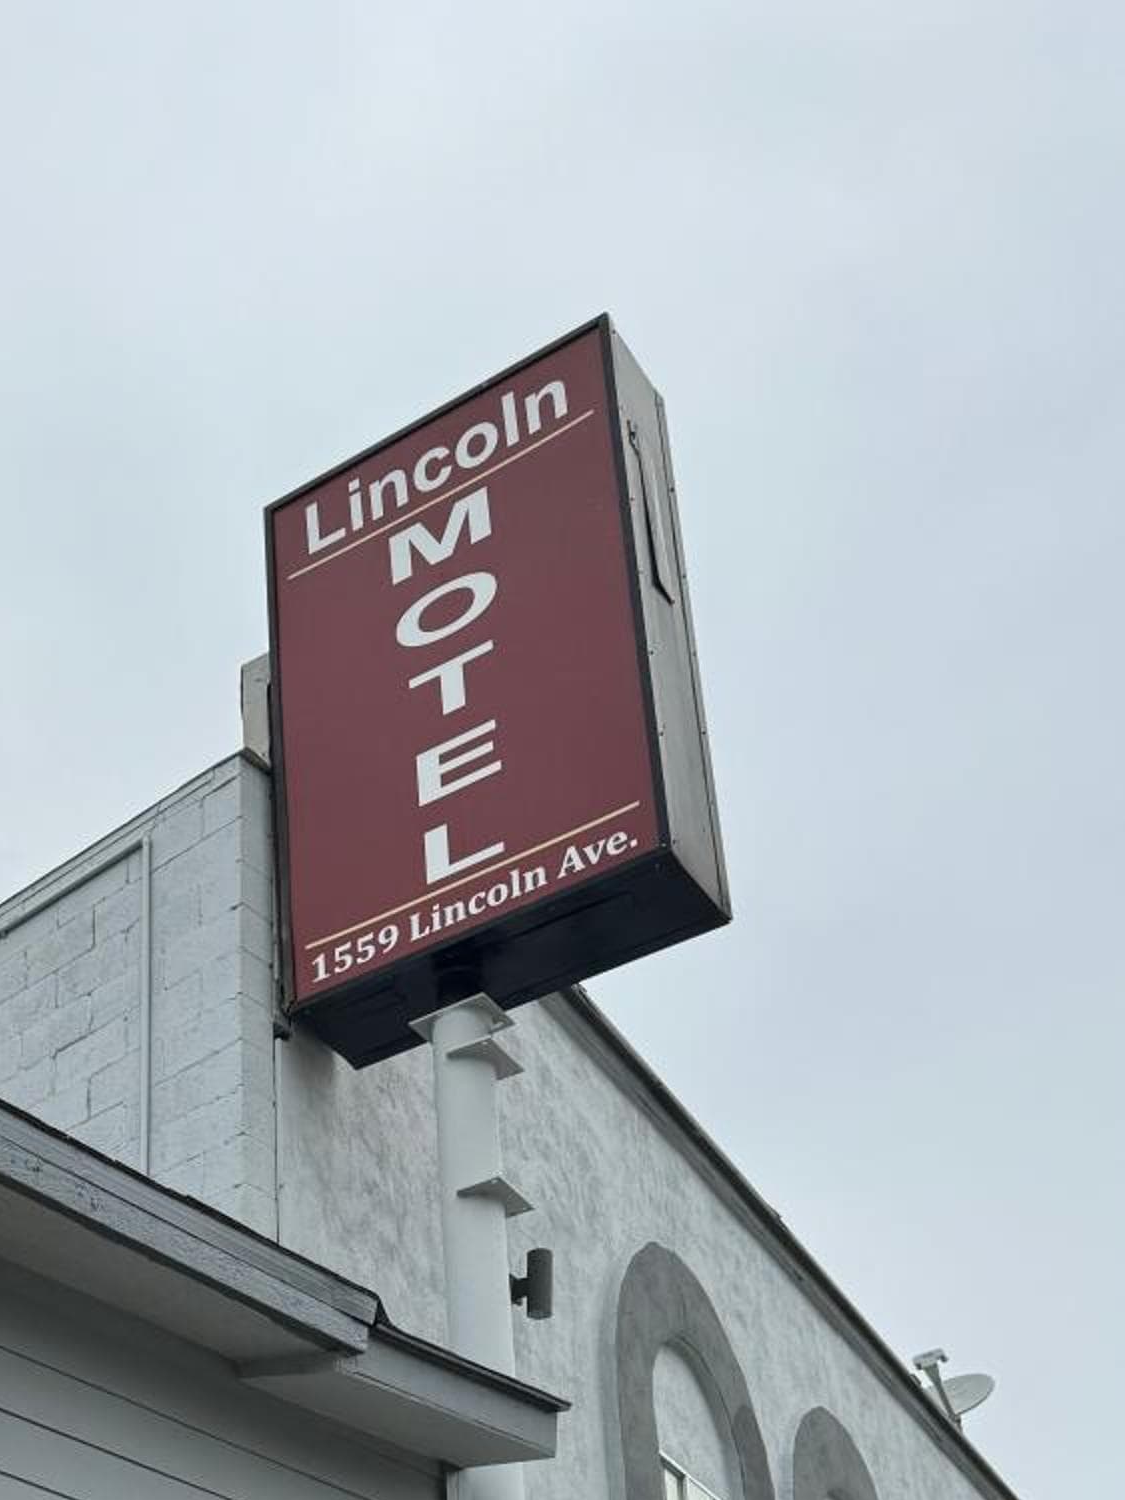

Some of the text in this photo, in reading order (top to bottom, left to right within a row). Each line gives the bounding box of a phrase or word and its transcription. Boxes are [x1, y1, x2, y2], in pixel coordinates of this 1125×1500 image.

[305, 380, 568, 555] Lincoln
[388, 487, 505, 885] MOTEL
[311, 831, 639, 984] 1559 Lincoln Ave.
